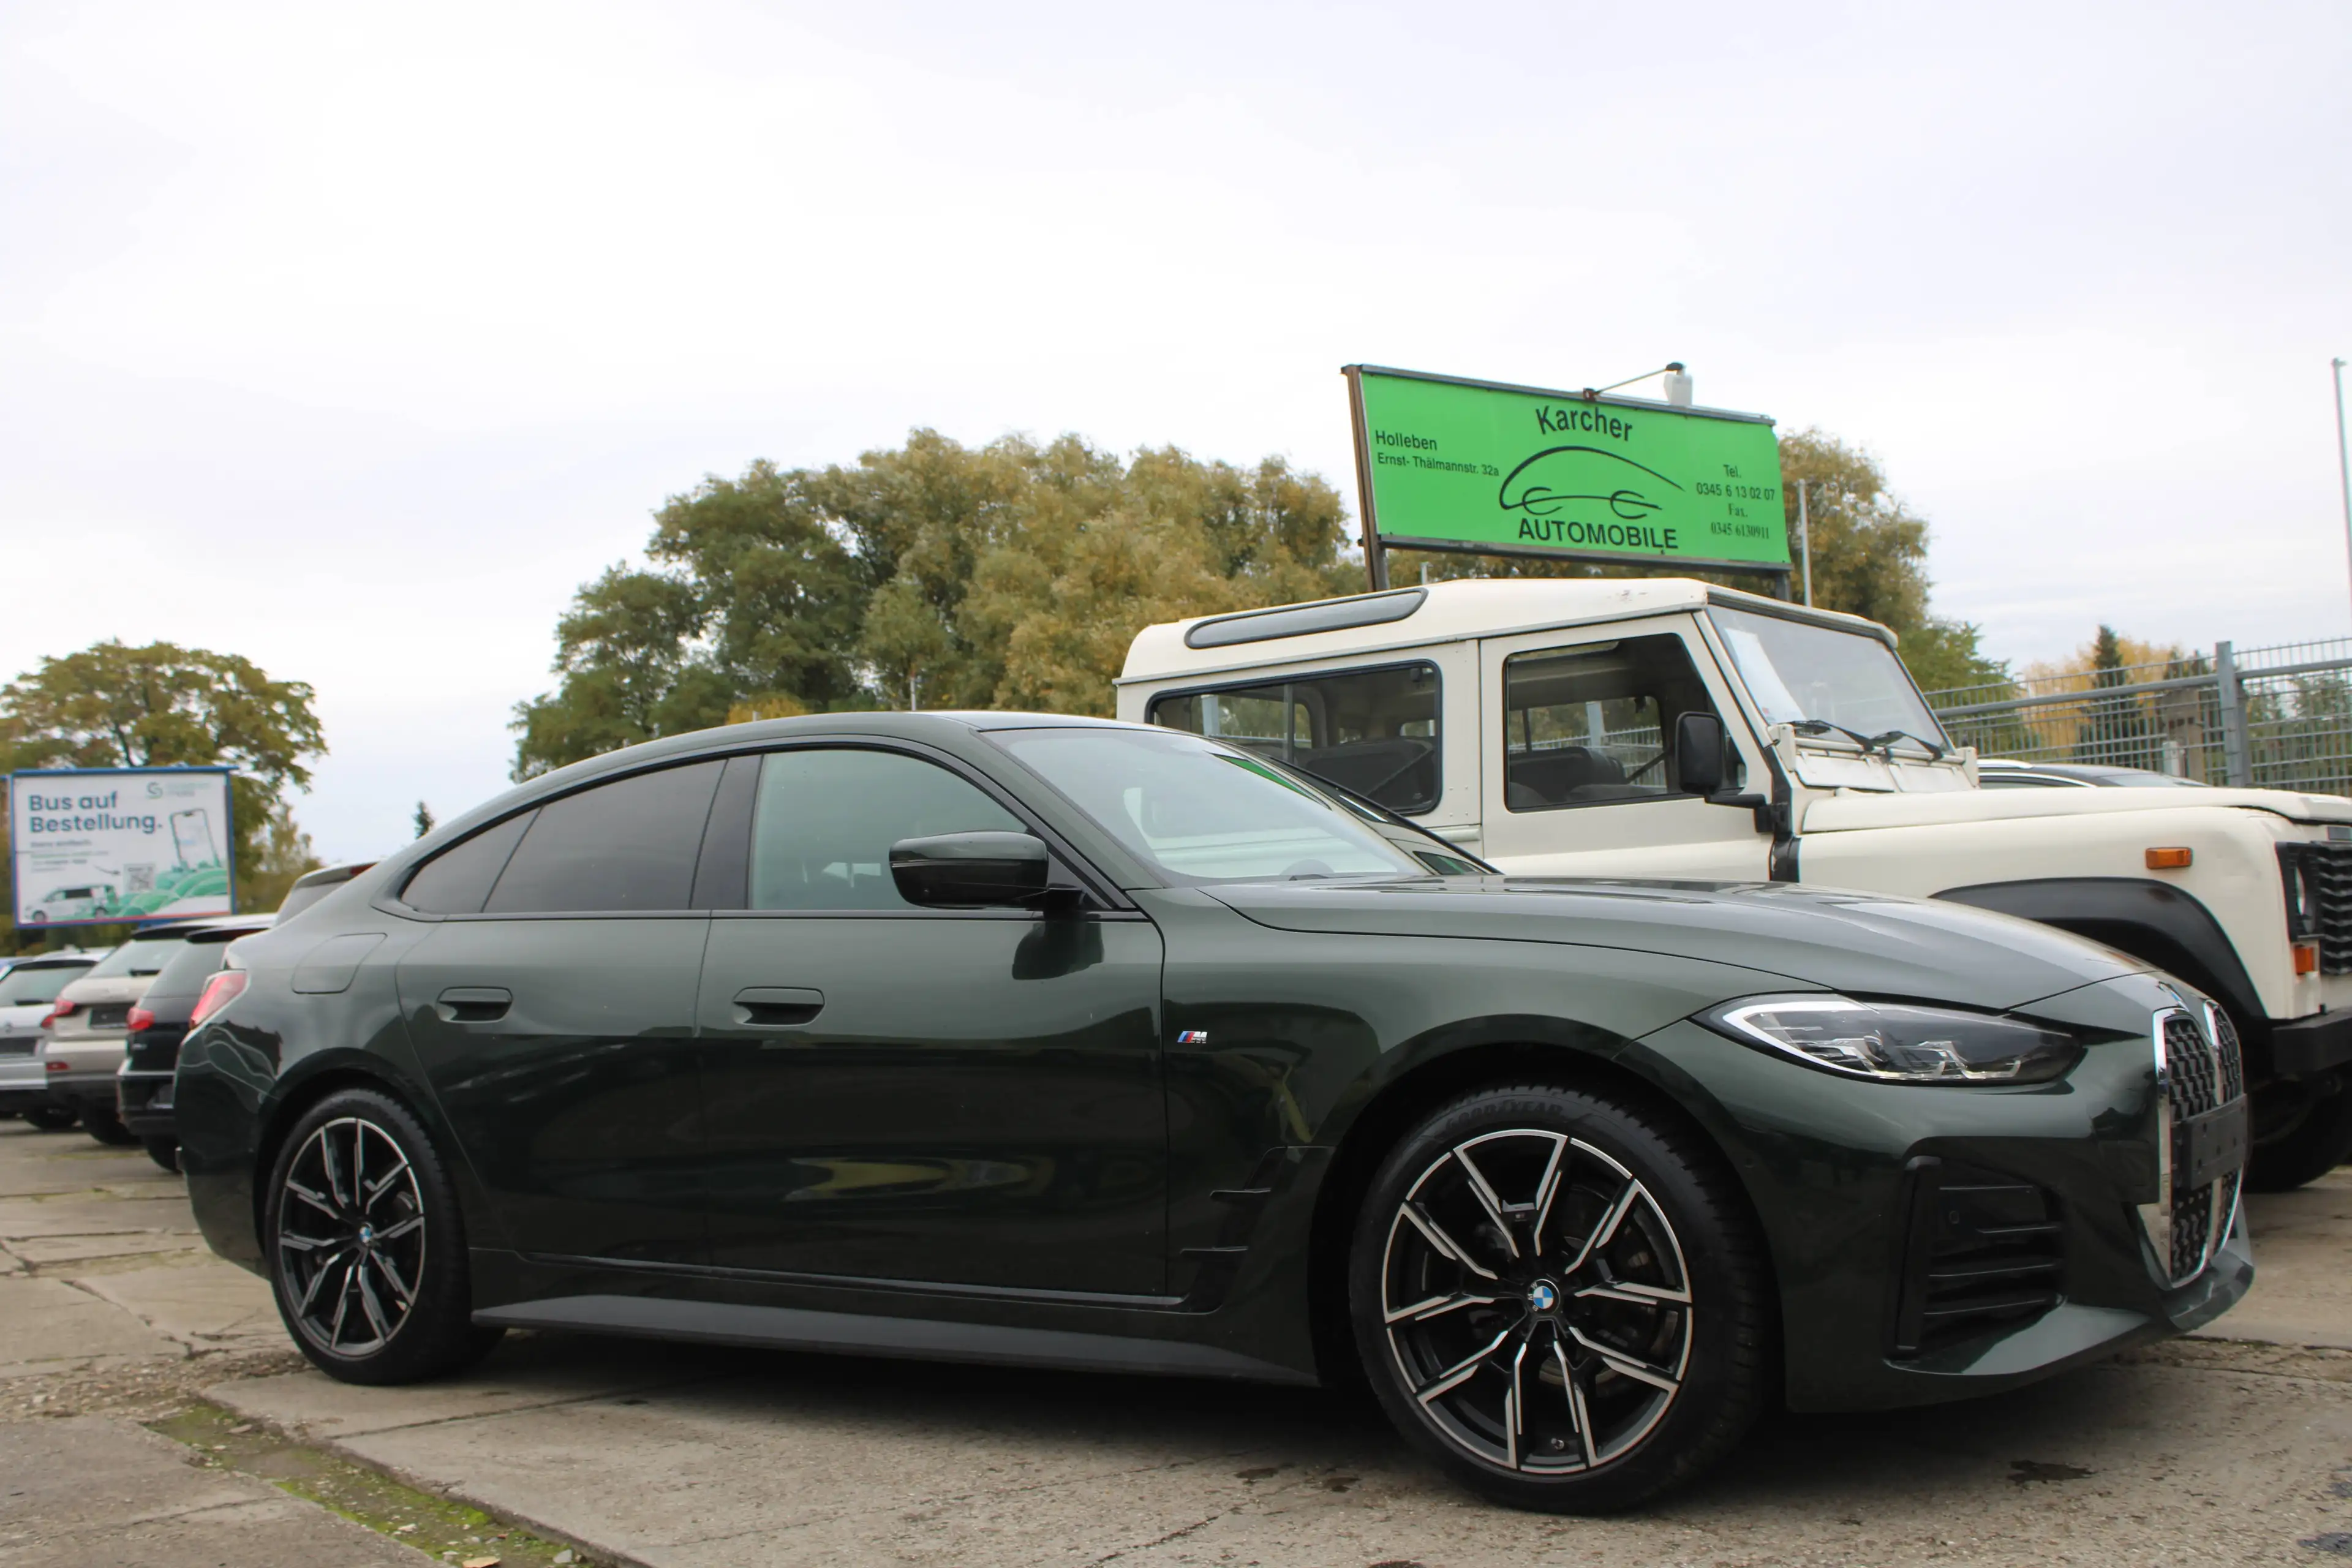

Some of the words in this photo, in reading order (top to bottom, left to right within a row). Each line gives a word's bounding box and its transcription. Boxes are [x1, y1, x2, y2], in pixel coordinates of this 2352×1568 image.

[1536, 405, 1632, 442] Karcher
[1375, 429, 1438, 451] Holleben
[1412, 456, 1479, 473] Thälmannstr.
[1481, 464, 1499, 477] 32a
[1723, 464, 1741, 478] Tel.
[1696, 482, 1722, 496] 0345
[1725, 484, 1732, 497] 6
[1735, 486, 1747, 498] 13
[1750, 486, 1762, 499] 02
[1764, 488, 1775, 500] 07
[1728, 503, 1748, 517] Fax.
[1519, 518, 1678, 549] AUTOMOBILE
[1711, 522, 1732, 536] 0345
[28, 794, 73, 812] Bus
[78, 791, 118, 810] auf
[29, 813, 163, 834] Bestellung.
